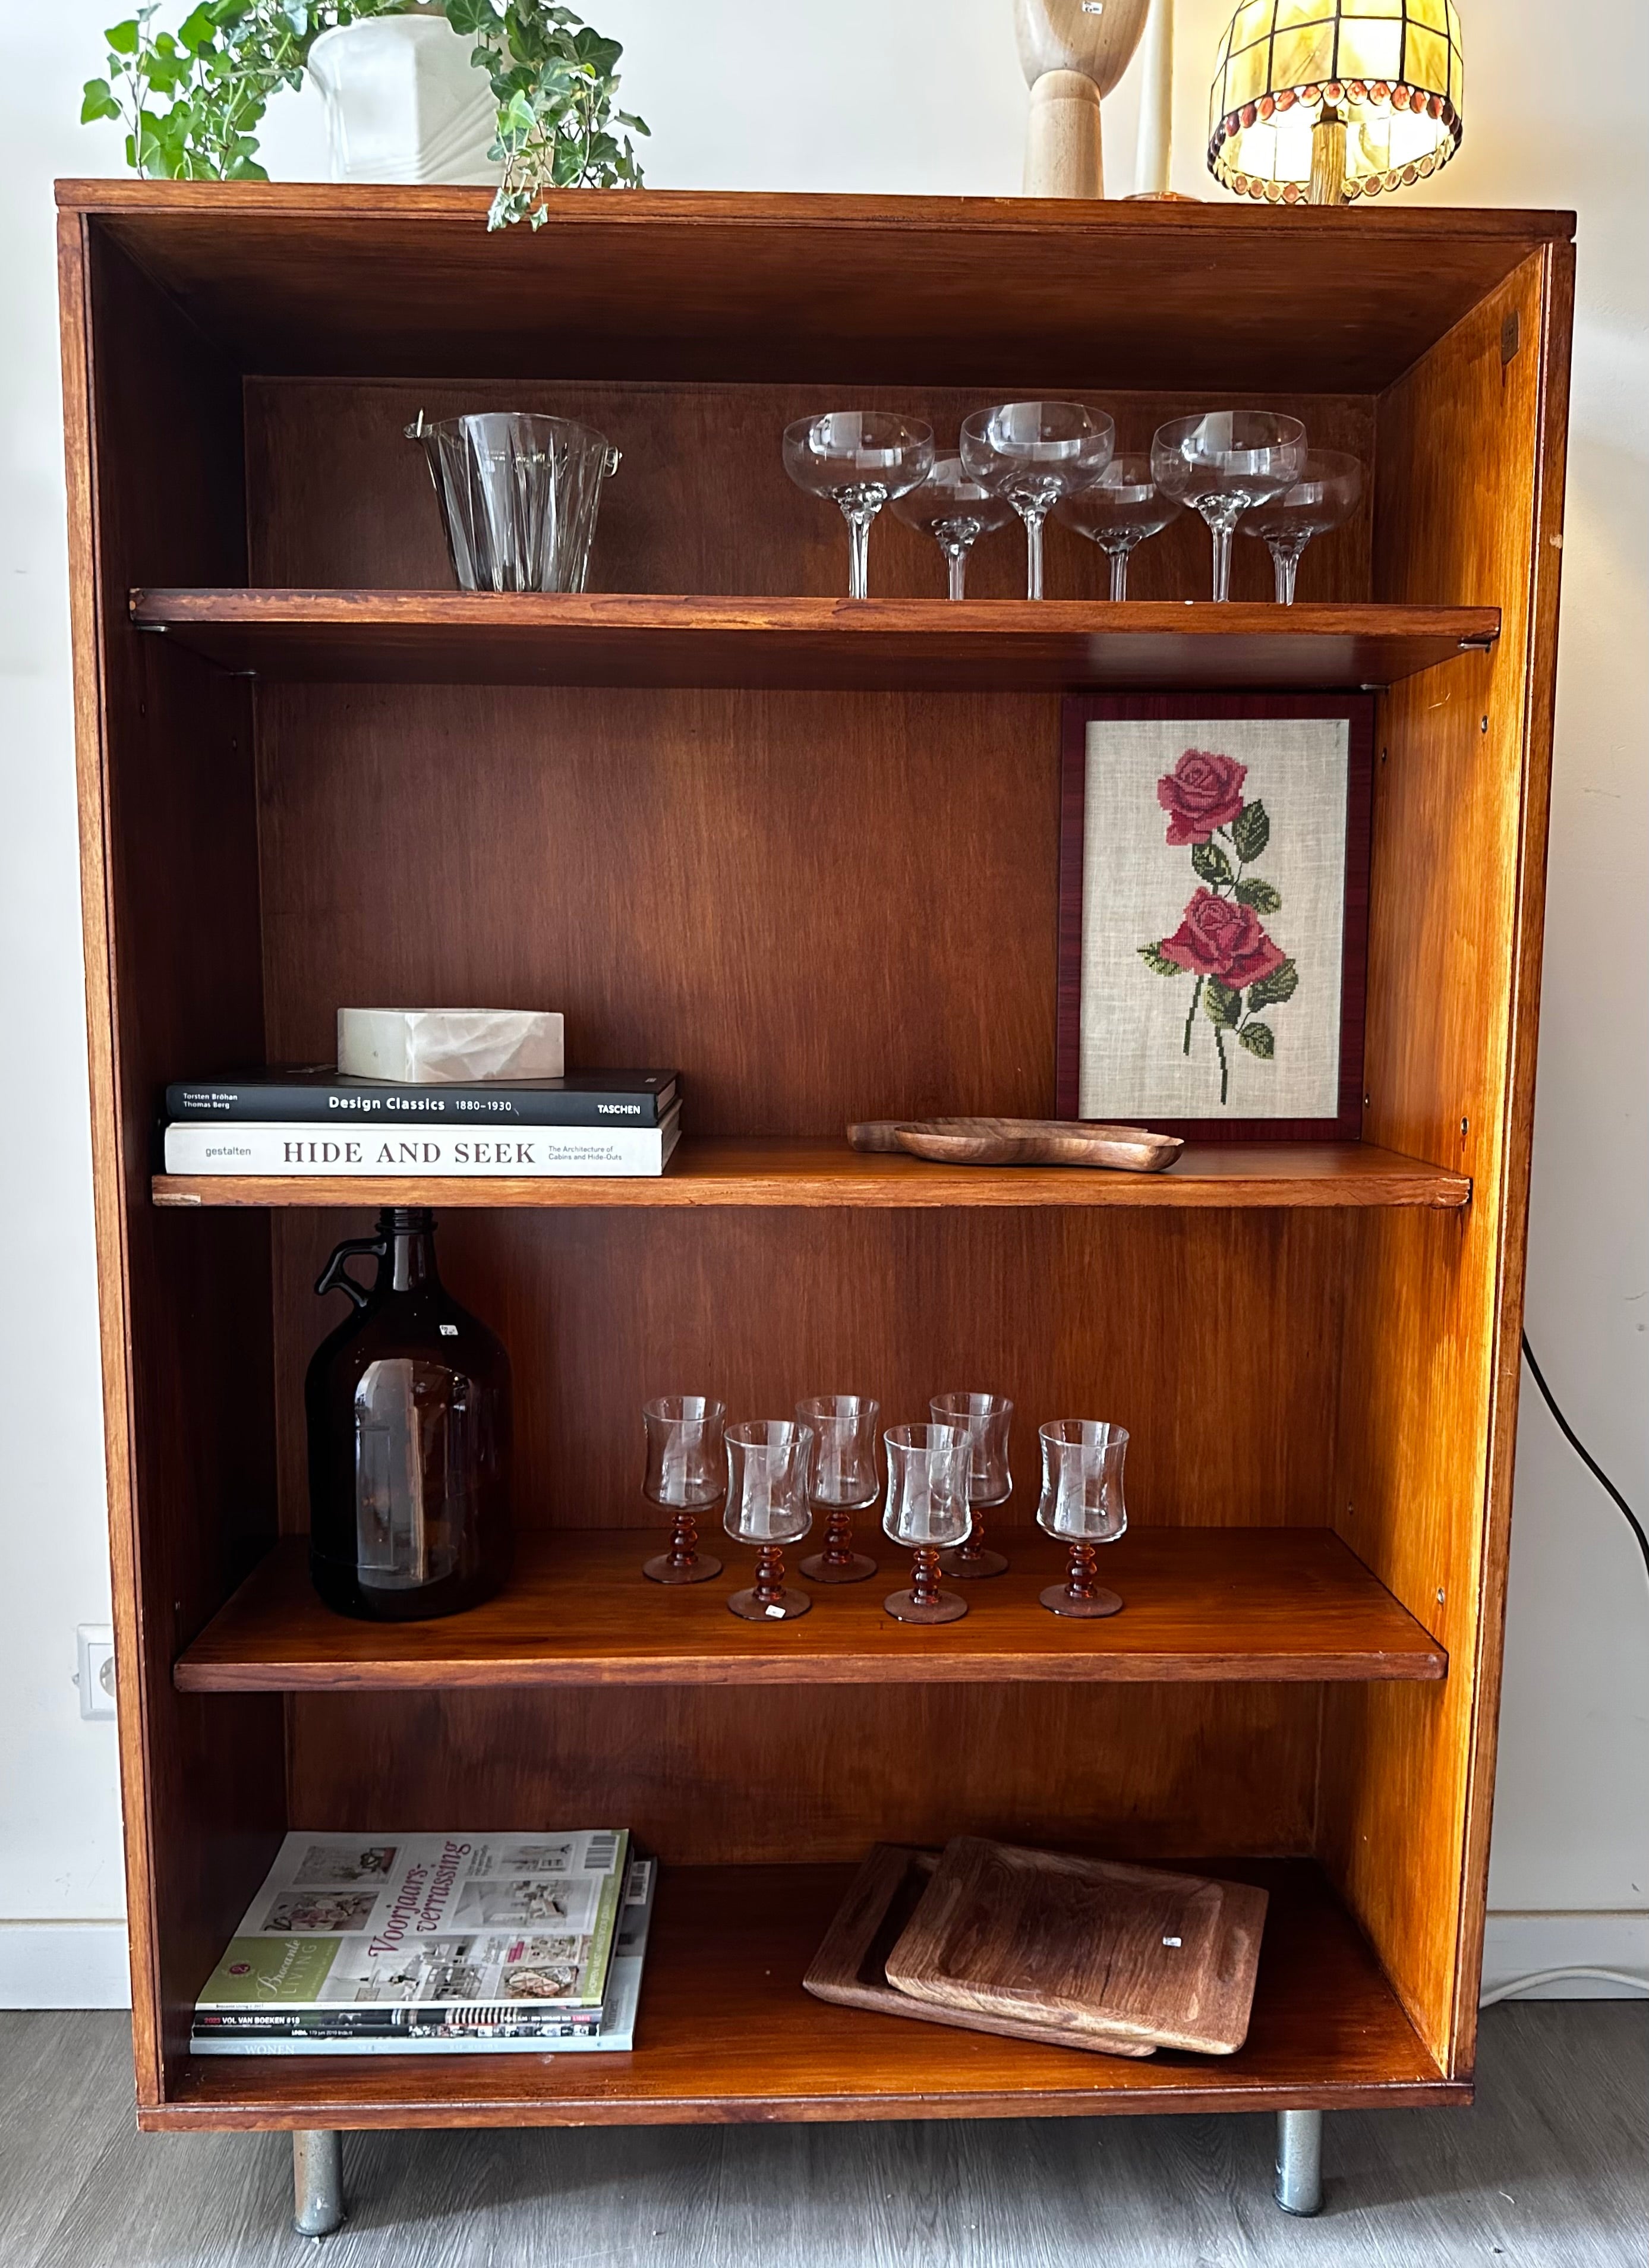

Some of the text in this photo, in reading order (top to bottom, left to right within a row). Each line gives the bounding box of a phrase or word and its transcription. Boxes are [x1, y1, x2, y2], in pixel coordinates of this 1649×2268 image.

[329, 1096, 512, 1111] Design Classics 1880-1930
[598, 1104, 641, 1114] TASCHEN
[206, 1146, 251, 1157] gestalten
[283, 1142, 535, 1163] HIDE AND SEEK
[417, 1841, 471, 1932] verrassing
[368, 1863, 428, 1957] Voorjaars-
[256, 1939, 301, 2000] Brocante
[282, 1945, 317, 1994] LIVING
[245, 2045, 295, 2055] WONEN
